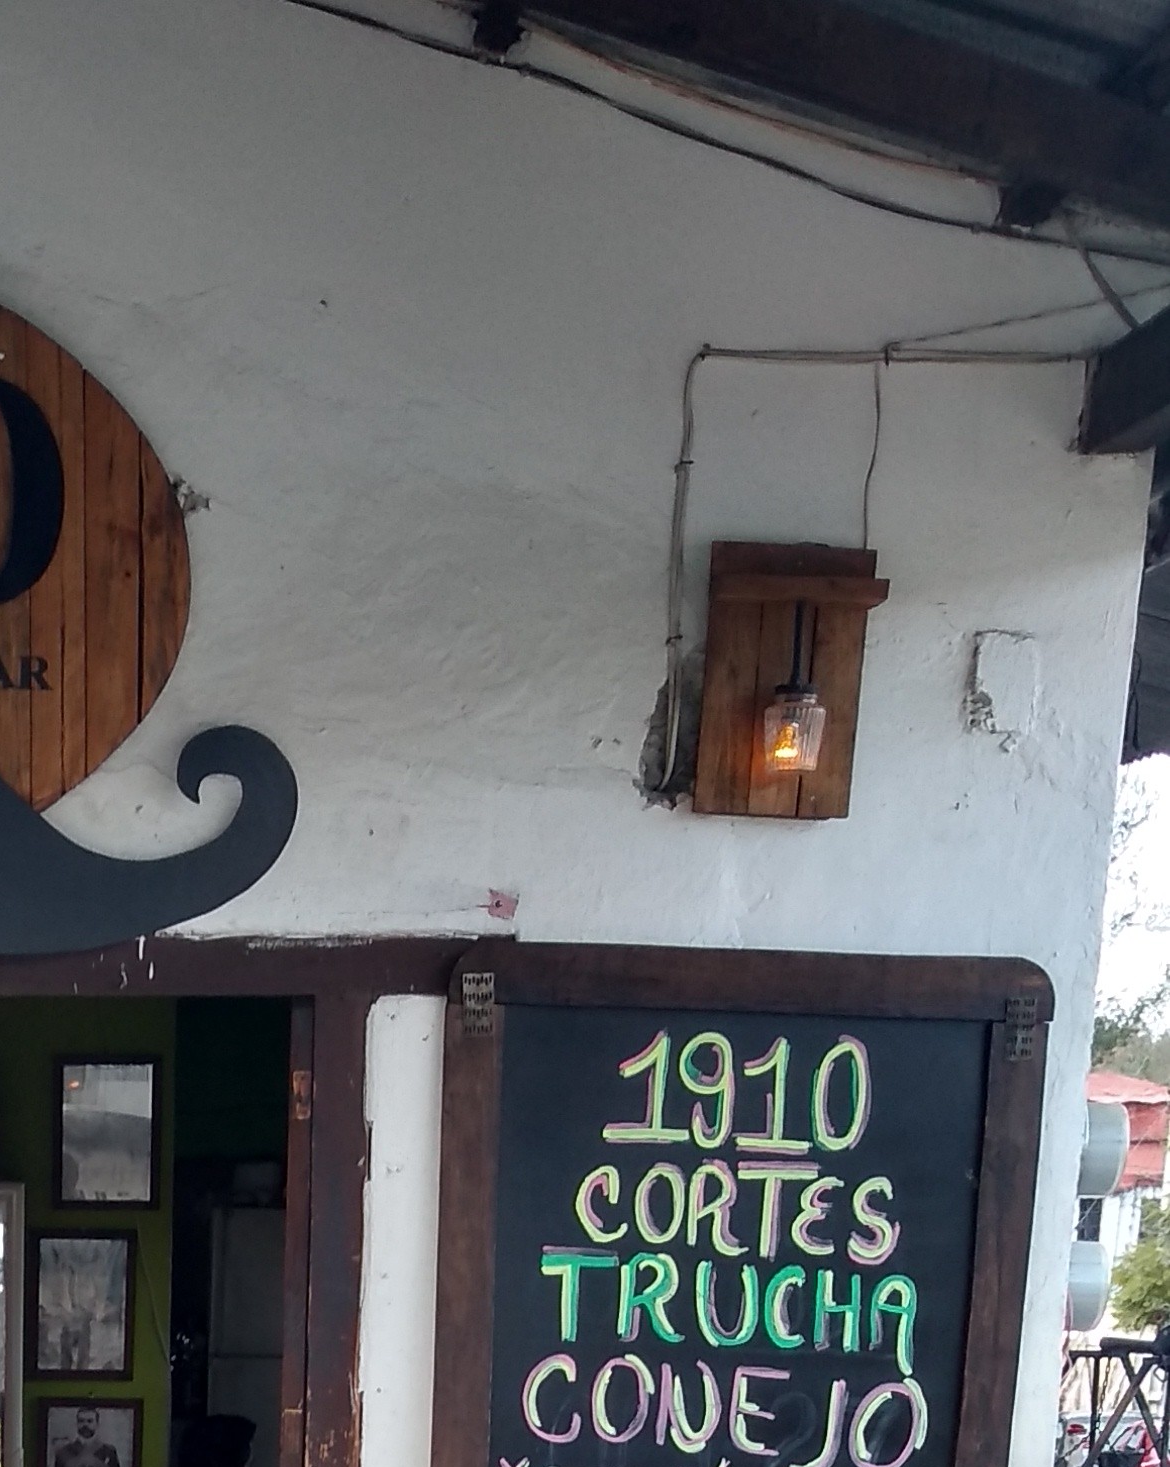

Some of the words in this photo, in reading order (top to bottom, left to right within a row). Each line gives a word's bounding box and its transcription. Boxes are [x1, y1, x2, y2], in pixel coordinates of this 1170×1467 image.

[603, 1029, 873, 1154] 1910
[575, 1159, 902, 1265] CORTES
[541, 1245, 918, 1375] TRUCHA
